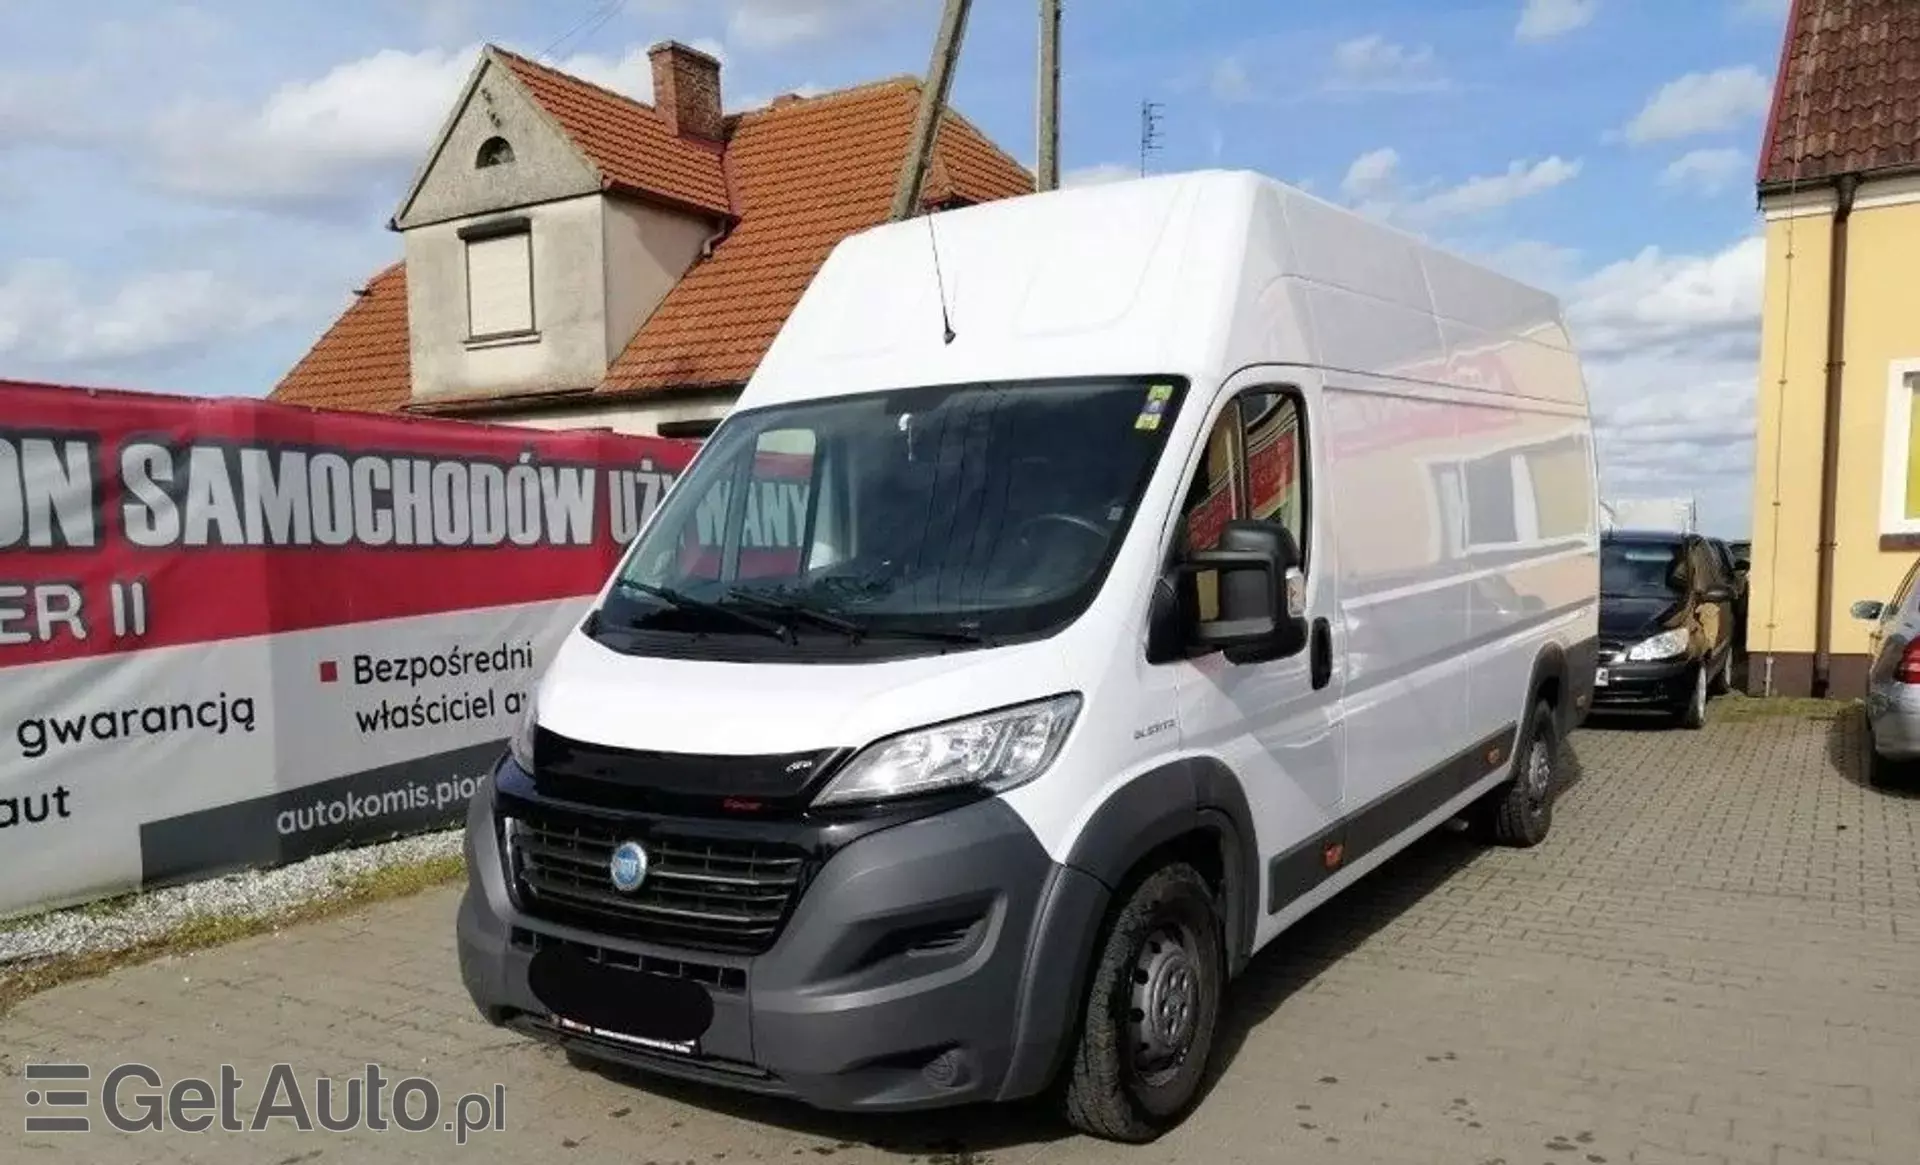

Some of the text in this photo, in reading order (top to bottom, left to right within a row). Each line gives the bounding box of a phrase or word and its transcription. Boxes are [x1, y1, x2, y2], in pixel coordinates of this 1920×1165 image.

[121, 443, 595, 547] SAMOCHODÓW
[354, 641, 533, 687] Bezpośredni
[17, 692, 255, 757] gwarancją
[356, 688, 494, 733] właściciel
[0, 785, 71, 828] aut
